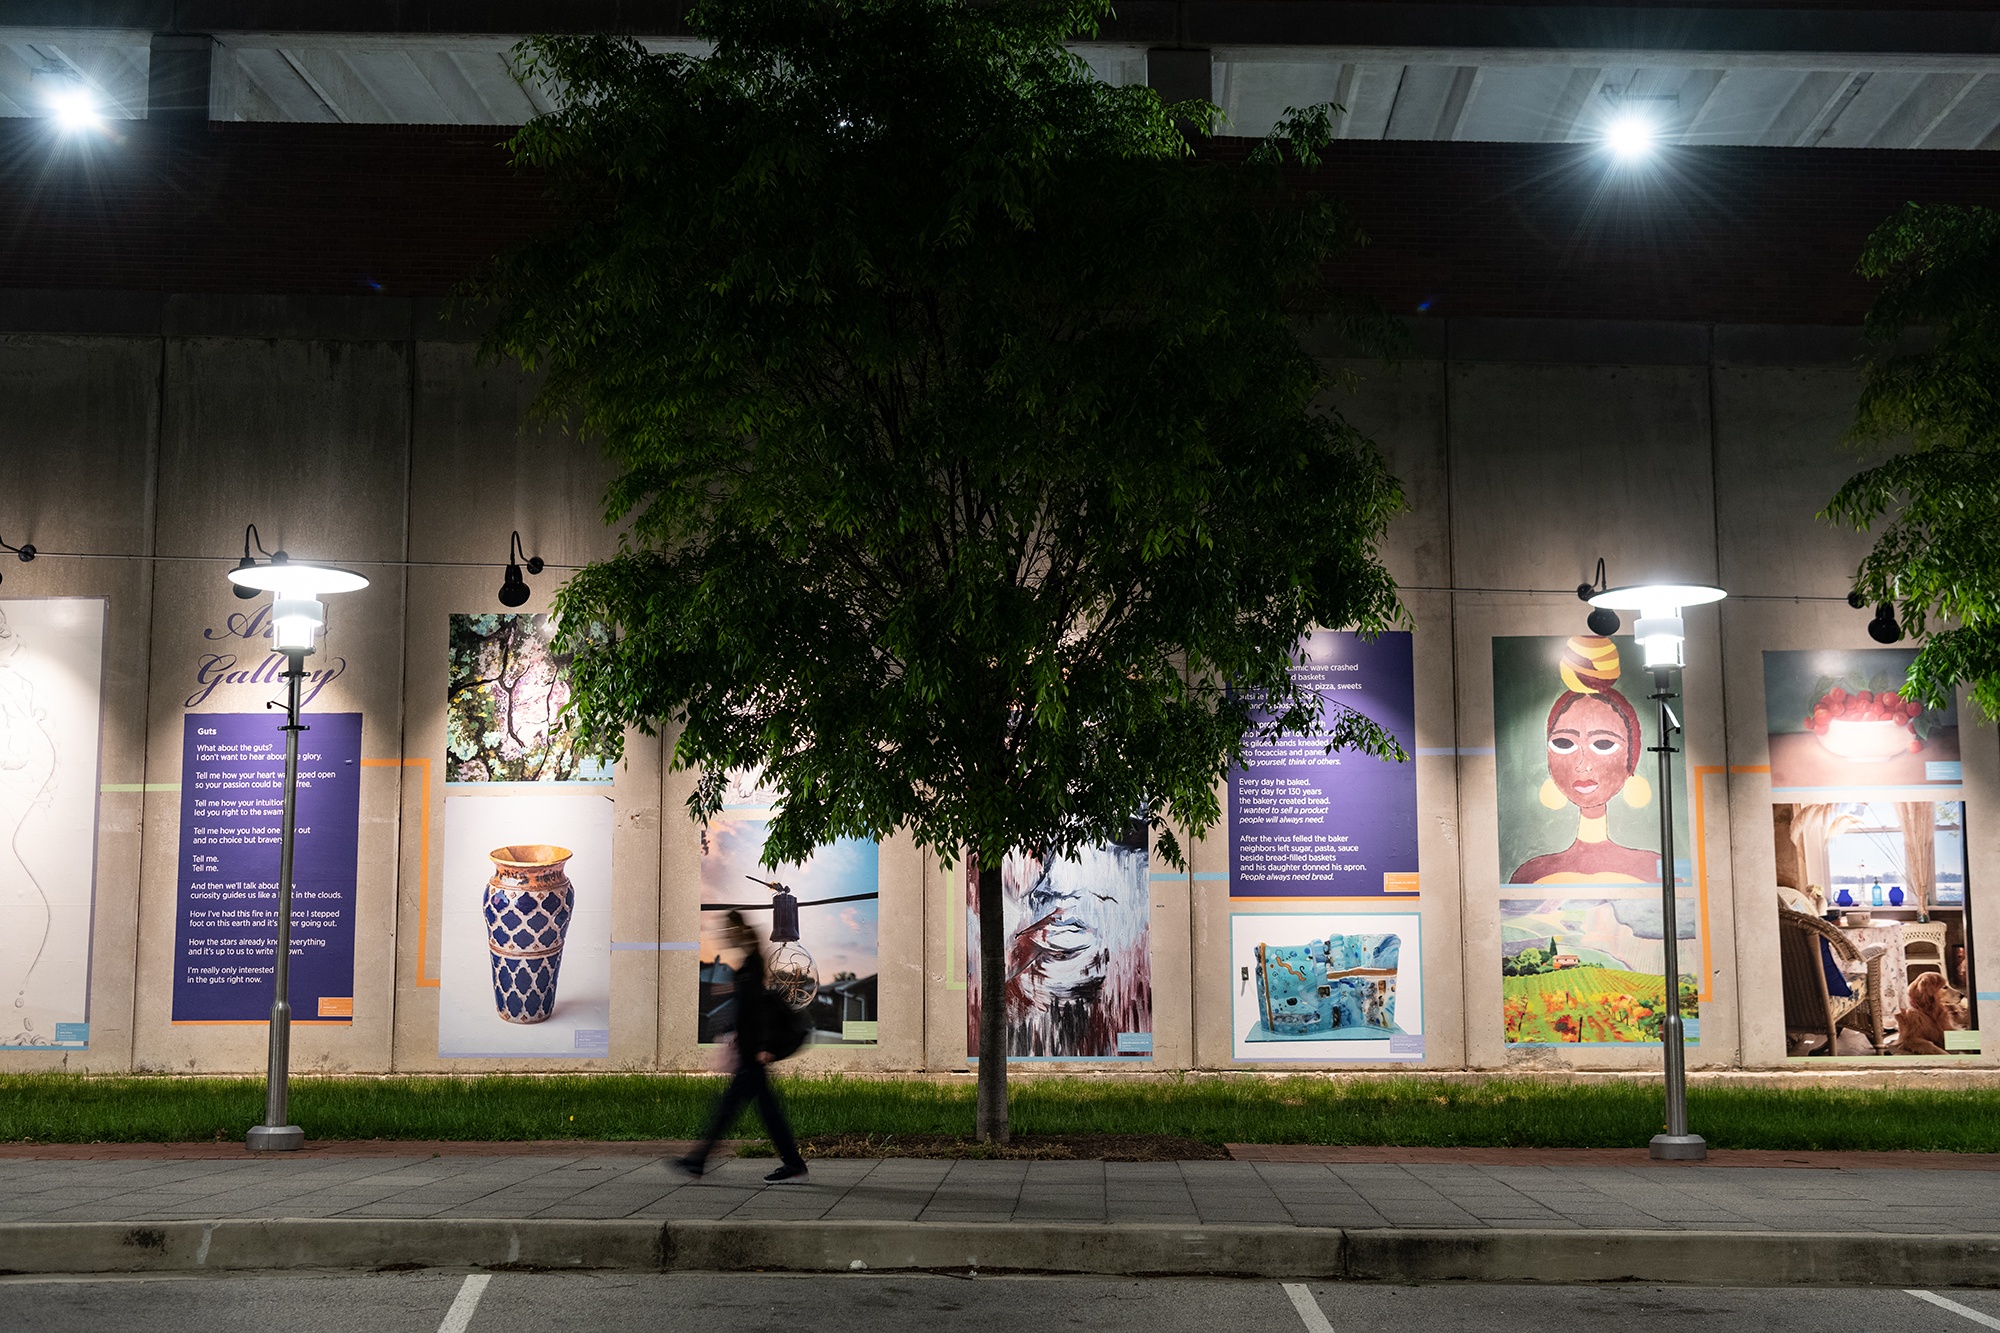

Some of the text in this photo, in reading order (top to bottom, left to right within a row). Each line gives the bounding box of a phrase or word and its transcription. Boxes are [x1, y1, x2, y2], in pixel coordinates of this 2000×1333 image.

[1330, 663, 1359, 671] crashed
[1298, 673, 1325, 681] baskets
[1315, 682, 1336, 691] pizza,
[1298, 739, 1329, 747] kneaded
[196, 744, 216, 752] What
[217, 744, 238, 752] about
[253, 744, 273, 752] guts?
[1254, 748, 1288, 757] focaccias
[1288, 748, 1303, 756] and
[200, 753, 219, 761] don't
[240, 753, 248, 761] to
[249, 753, 265, 761] hear
[302, 752, 322, 761] glory.
[1256, 758, 1287, 767] yourself,
[1288, 758, 1307, 766] think
[195, 771, 208, 780] Tell
[222, 771, 238, 779] how
[239, 772, 256, 780] your
[256, 771, 276, 779] heart
[317, 772, 336, 780] open
[205, 782, 222, 790] your
[223, 781, 250, 789] passion
[251, 780, 271, 788] could
[272, 780, 282, 788] be
[1239, 778, 1311, 787] Every day he baked.
[1239, 787, 1322, 797] Every day for 130 years
[194, 799, 207, 807] Tell
[221, 799, 237, 807] how
[238, 800, 254, 808] your
[1239, 796, 1331, 806] the bakery created bread.
[194, 808, 206, 816] led
[206, 810, 220, 818] you
[221, 808, 239, 817] right
[249, 808, 262, 816] the
[1243, 806, 1271, 814] wanted
[1280, 806, 1293, 814] sell
[1299, 806, 1329, 815] product
[1239, 816, 1265, 824] people
[1279, 816, 1304, 824] always
[194, 827, 206, 835] Tell
[236, 828, 250, 836] you
[252, 826, 266, 834] had
[298, 826, 311, 834] out
[193, 836, 207, 844] and
[219, 836, 243, 844] choice
[244, 836, 256, 844] but
[1240, 834, 1258, 842] After
[1292, 834, 1313, 842] felled
[1328, 834, 1349, 842] baker
[1240, 844, 1276, 853] neighbors
[1277, 844, 1290, 852] left
[1314, 845, 1336, 853] pasta,
[192, 855, 205, 863] Tell
[1240, 854, 1336, 862] beside bread-filled baskets
[192, 864, 204, 872] Tell
[1240, 863, 1367, 872] and his daughter donned his apron.
[1240, 872, 1334, 882] People always need bread.
[190, 882, 206, 890] And
[207, 882, 224, 890] then
[225, 882, 242, 890] we'll
[258, 882, 279, 890] about
[190, 891, 221, 900] curiosity
[222, 891, 246, 900] guides
[258, 891, 270, 899] like
[304, 891, 316, 899] the
[317, 891, 343, 899] clouds.
[190, 910, 206, 918] How
[208, 910, 220, 918] I've
[222, 910, 236, 918] had
[237, 910, 250, 918] this
[252, 910, 264, 918] fire
[310, 910, 340, 918] stepped
[190, 919, 204, 927] foot
[217, 919, 230, 927] this
[231, 919, 251, 927] earth
[252, 919, 266, 927] and
[267, 919, 278, 927] it's
[300, 919, 322, 928] going
[188, 938, 266, 947] How the stars already
[188, 947, 202, 956] and
[203, 947, 214, 956] it's
[255, 947, 274, 955] write
[187, 966, 274, 975] I'm really only interested
[195, 976, 208, 984] the
[209, 976, 225, 985] guts
[226, 975, 244, 985] right
